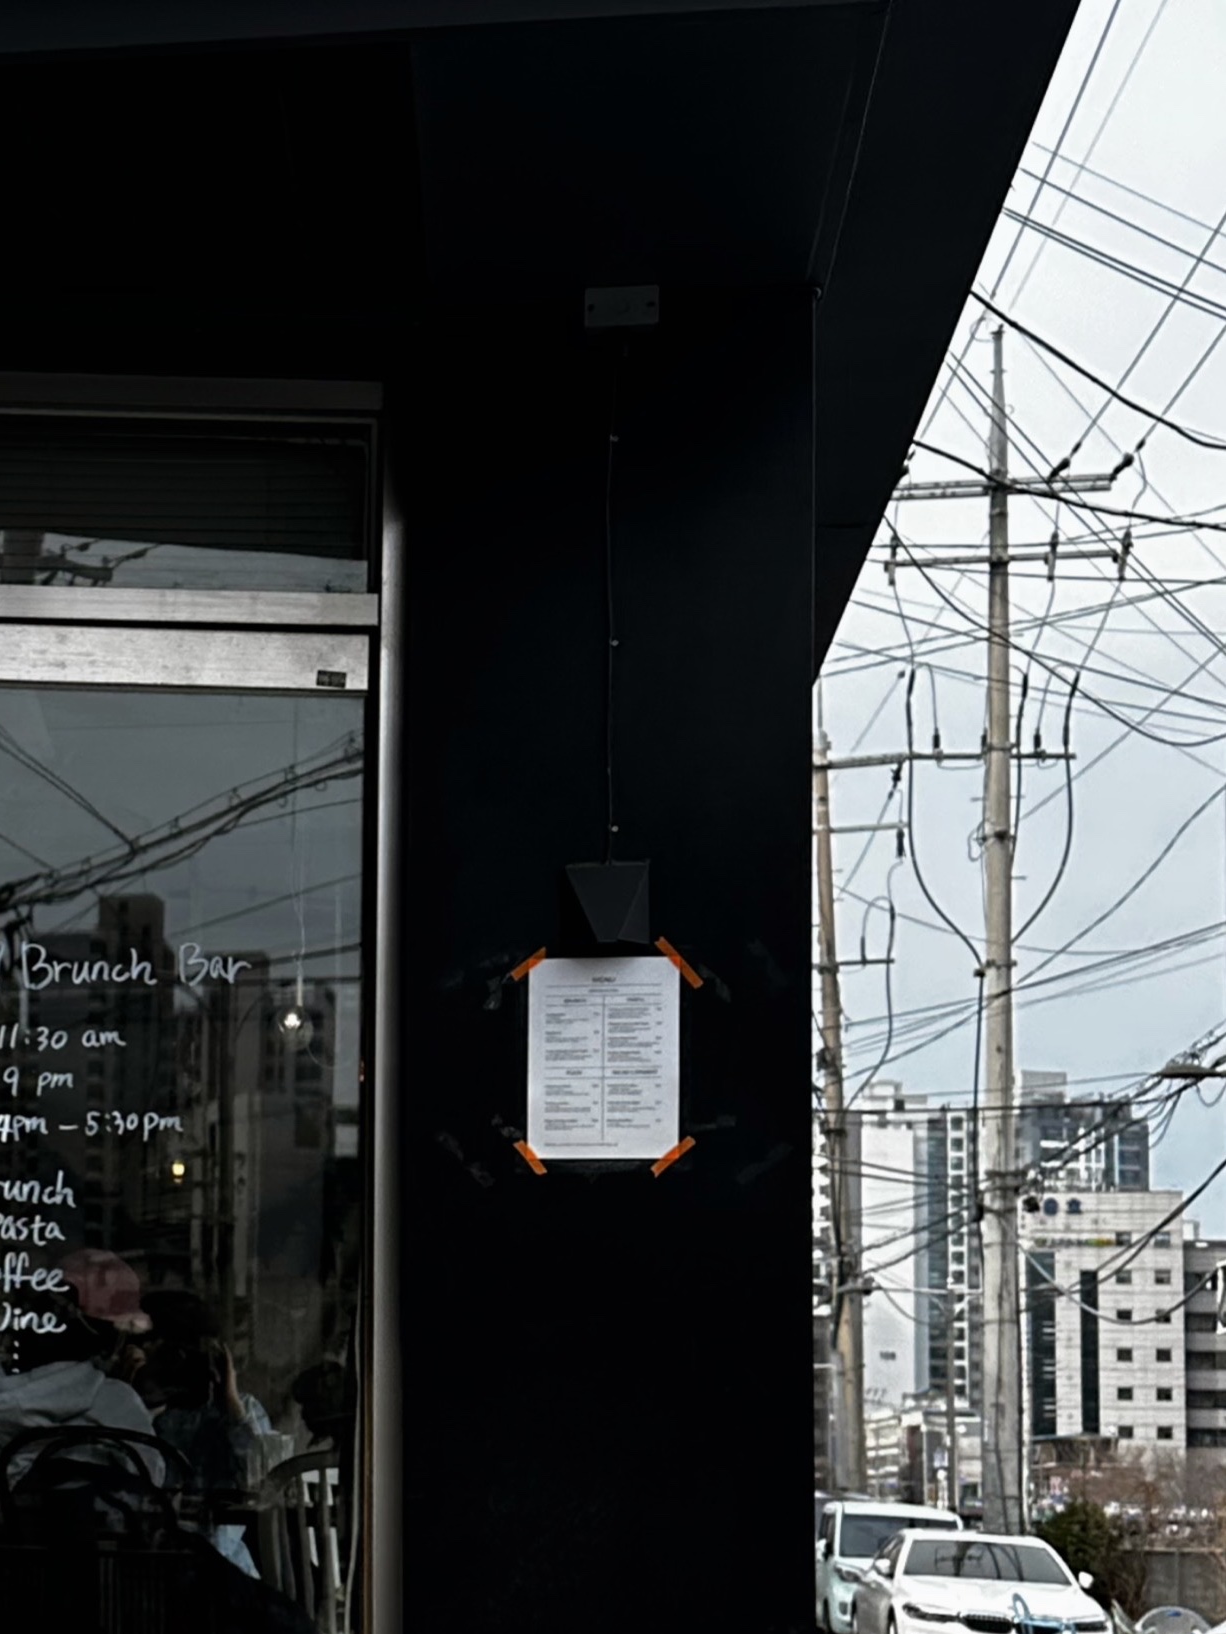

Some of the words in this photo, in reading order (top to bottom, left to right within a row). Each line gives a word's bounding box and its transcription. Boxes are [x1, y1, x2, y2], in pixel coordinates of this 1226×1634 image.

[20, 940, 158, 991] Brunch
[178, 942, 254, 985] Bar
[81, 1031, 127, 1049] am
[3, 1066, 20, 1097] 9
[36, 1072, 74, 1097] pm
